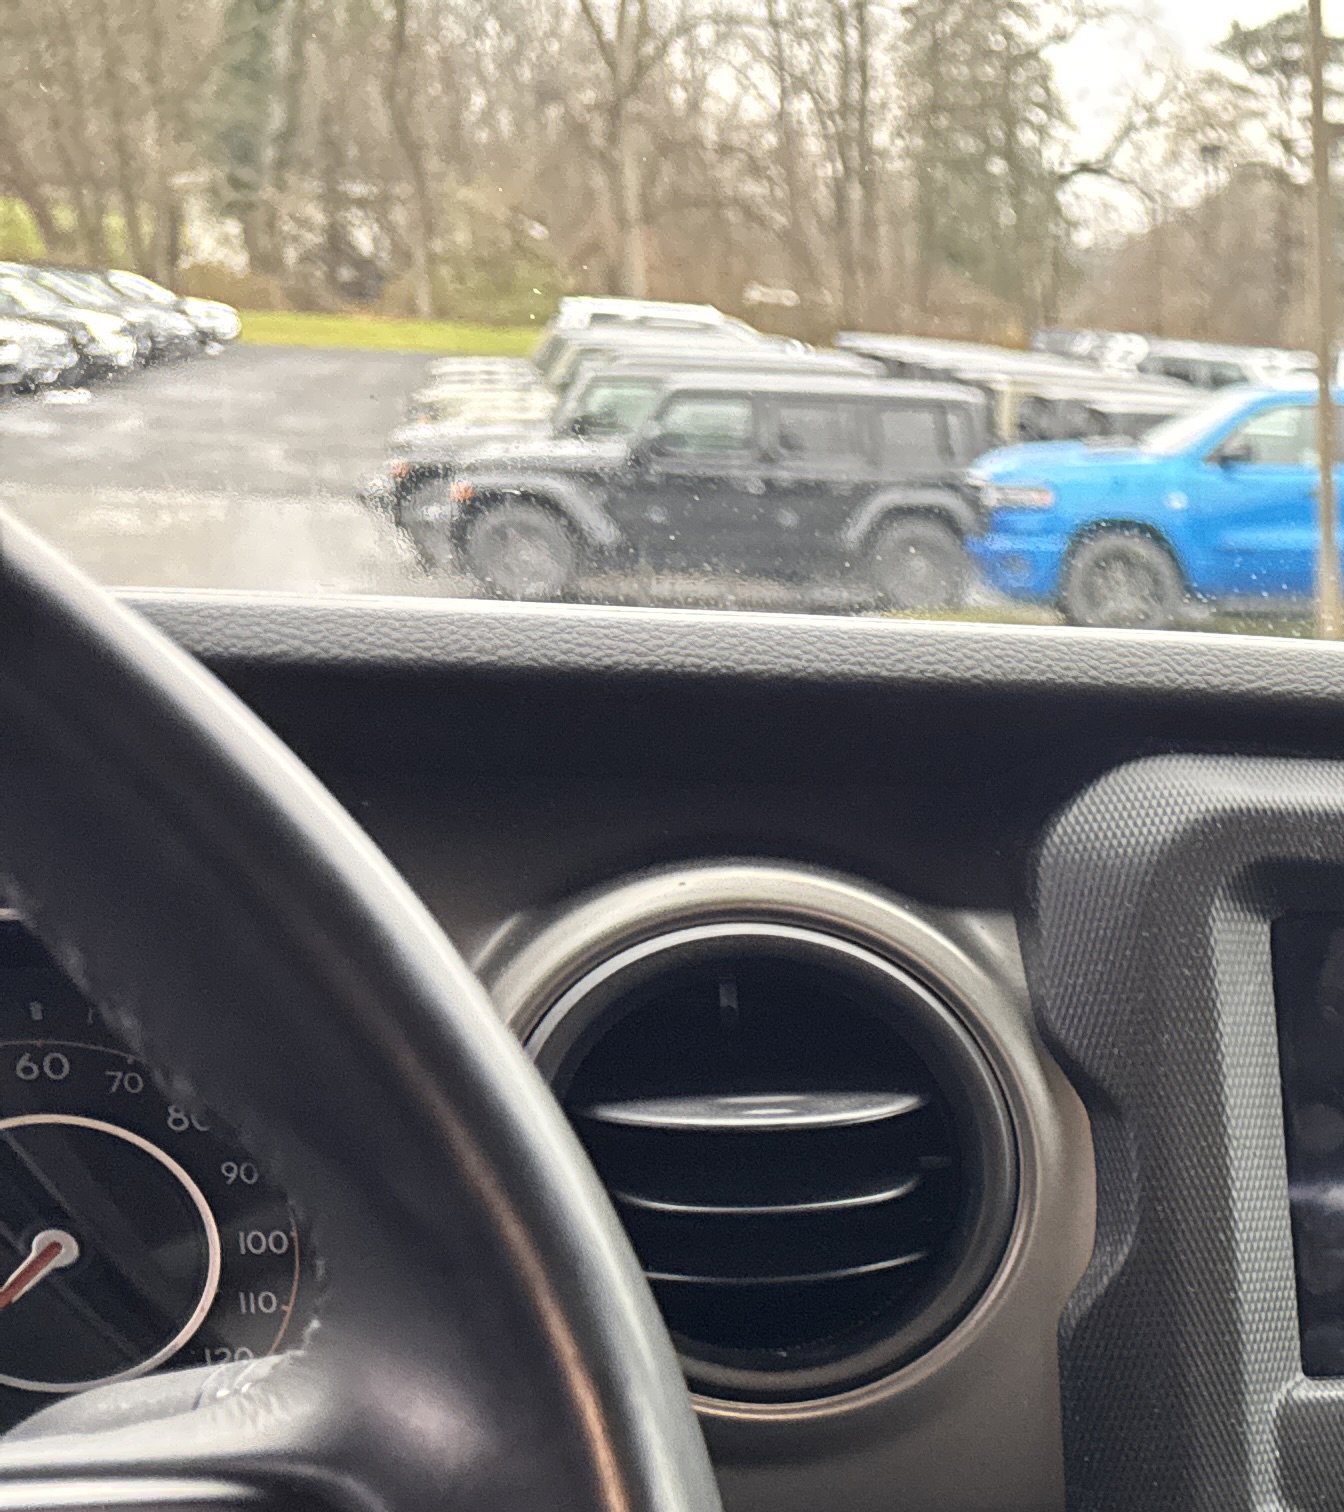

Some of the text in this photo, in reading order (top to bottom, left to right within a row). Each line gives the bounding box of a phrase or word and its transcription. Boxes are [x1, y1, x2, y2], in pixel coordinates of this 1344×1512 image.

[15, 1052, 70, 1080] 60
[105, 1071, 144, 1094] 70
[220, 1161, 259, 1184] 90
[238, 1231, 289, 1255] 100
[238, 1291, 278, 1314] 110
